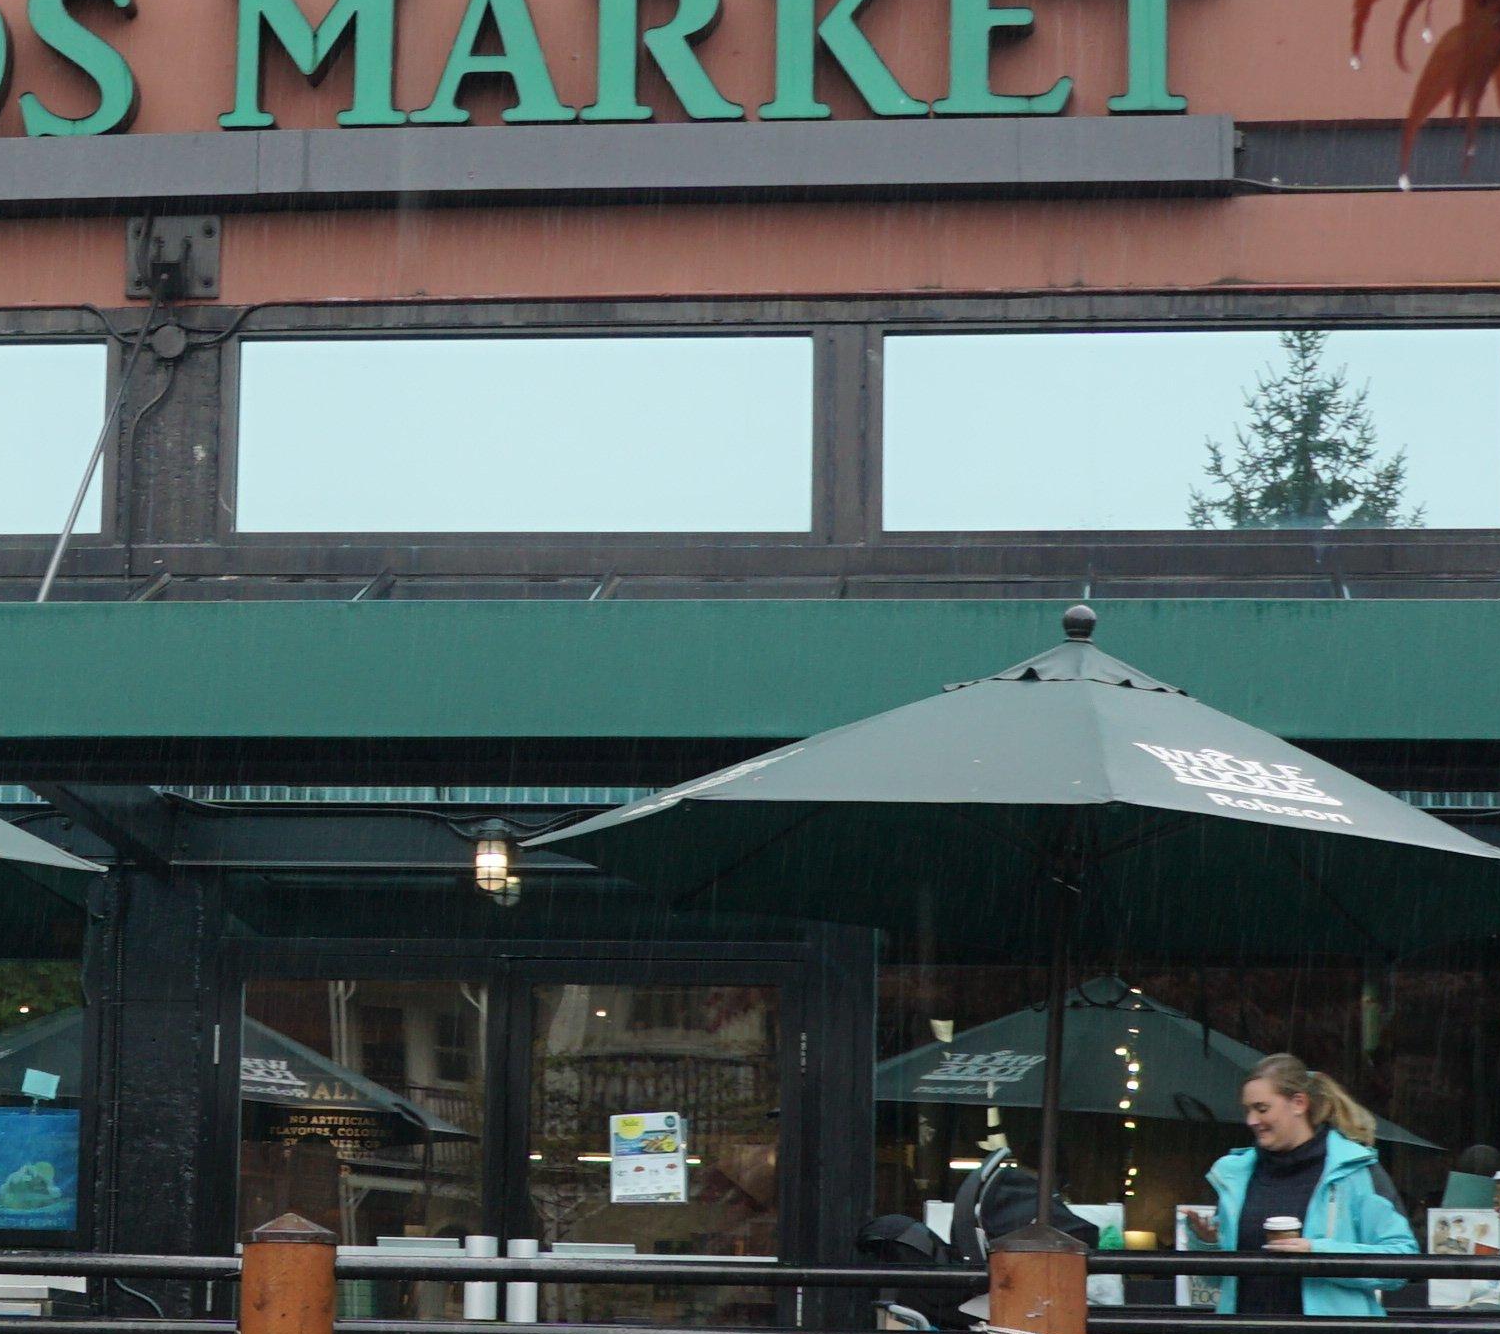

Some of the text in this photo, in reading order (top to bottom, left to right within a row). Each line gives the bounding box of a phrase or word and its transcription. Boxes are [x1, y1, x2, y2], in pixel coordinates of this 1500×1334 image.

[1132, 742, 1316, 783] WHOLE
[1161, 760, 1326, 798] FOODS
[1206, 792, 1355, 825] Robson
